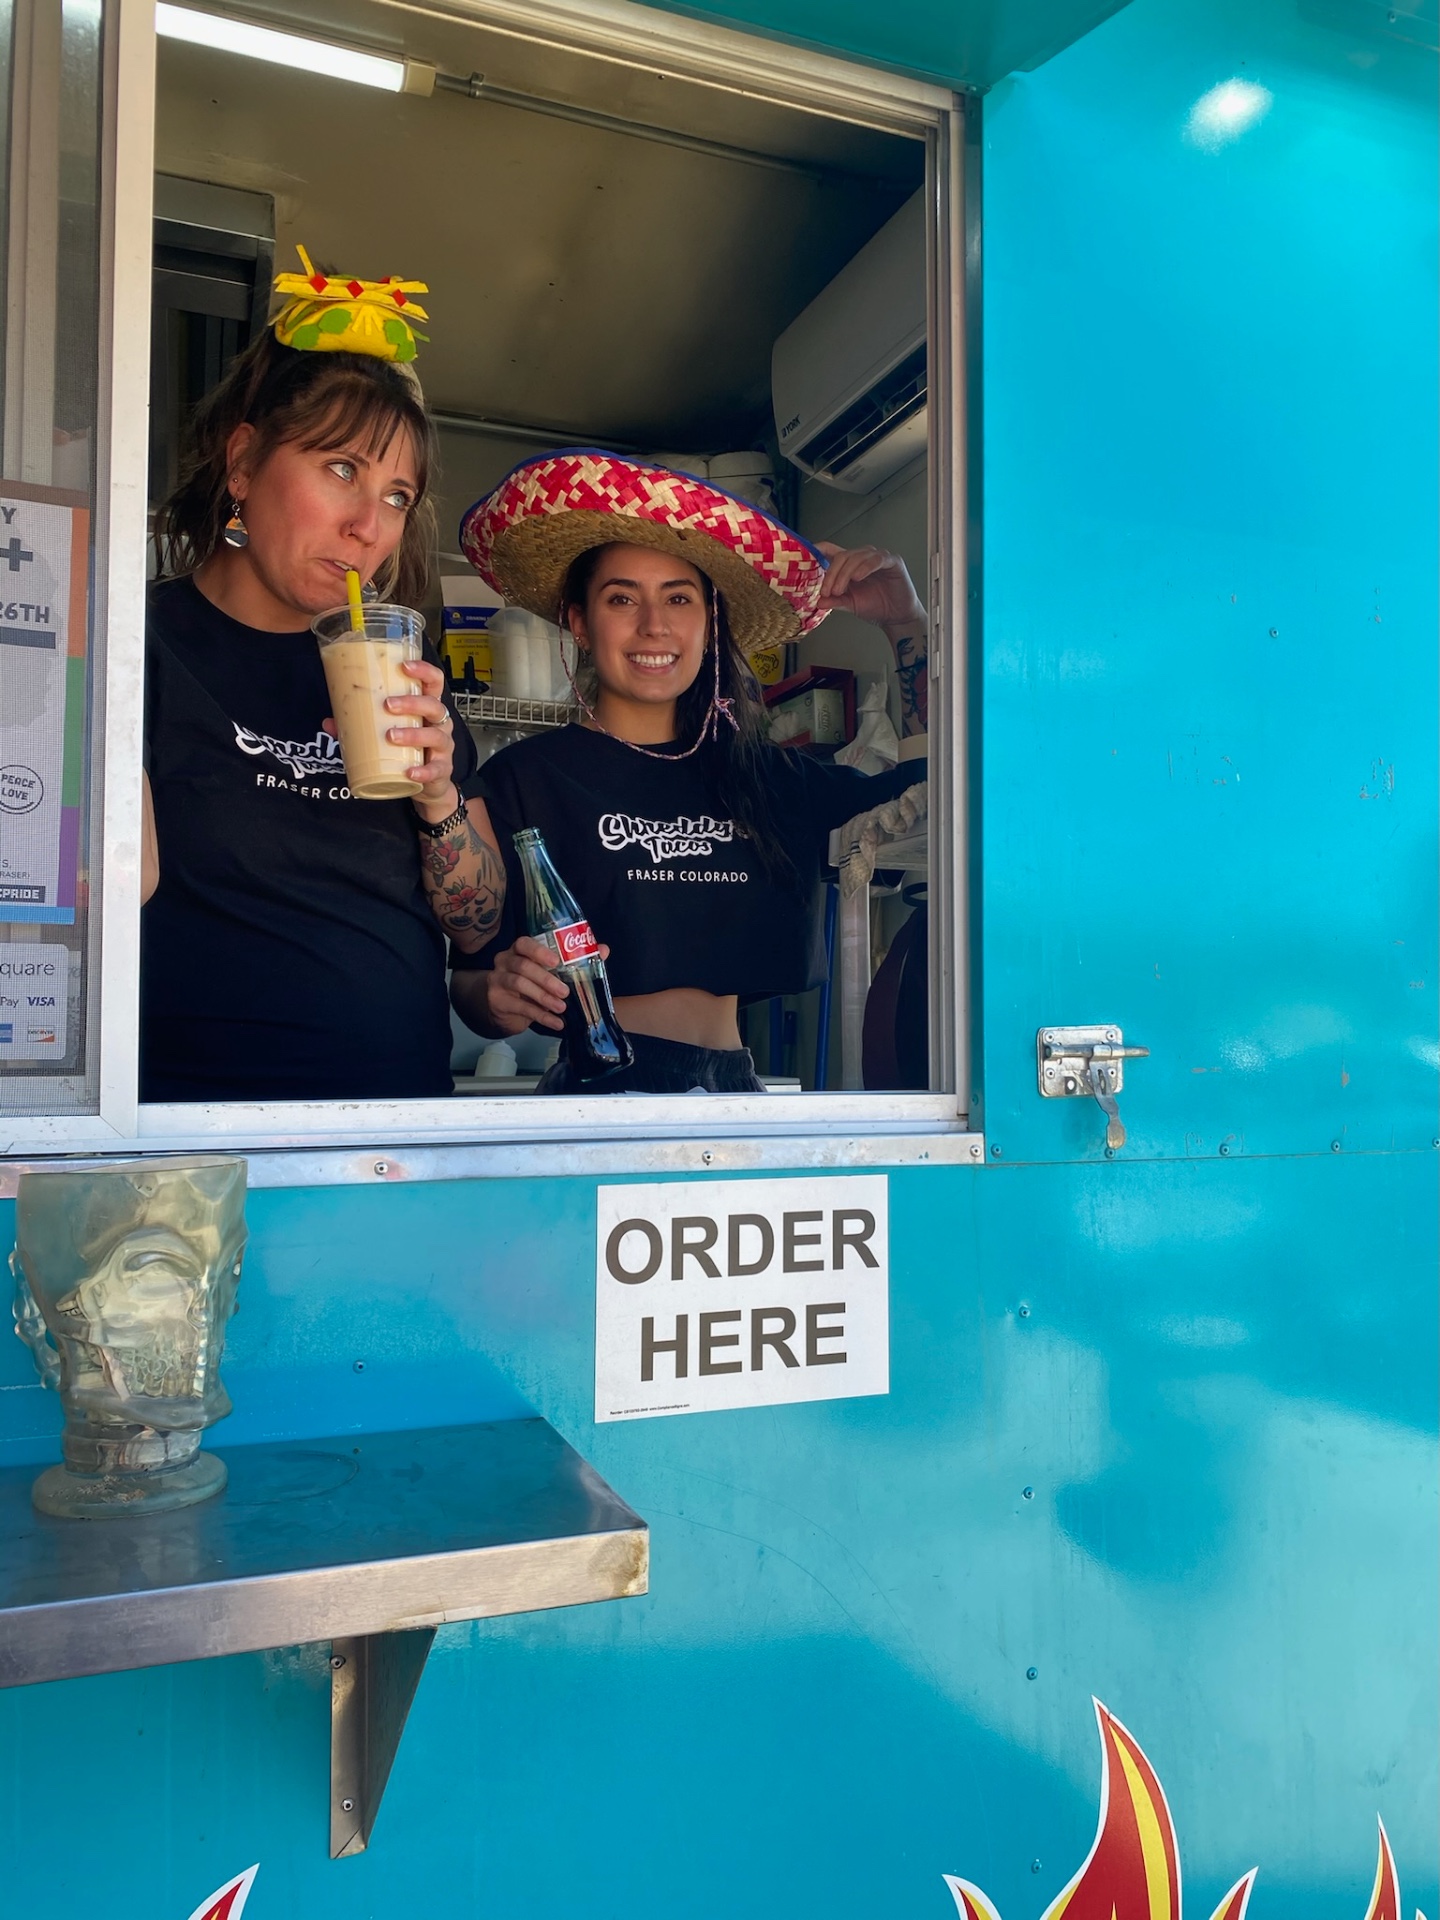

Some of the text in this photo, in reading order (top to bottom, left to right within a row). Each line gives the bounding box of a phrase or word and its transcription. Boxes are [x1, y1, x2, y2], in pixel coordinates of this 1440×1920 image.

[1, 774, 36, 789] PEACE
[256, 774, 361, 800] FRASER CO
[1, 787, 29, 801] LOVE
[640, 836, 713, 864] Tacos
[627, 869, 749, 883] FRASER COLORADO
[27, 996, 56, 1007] VISA
[605, 1208, 881, 1285] ORDER
[640, 1302, 848, 1383] HERE
